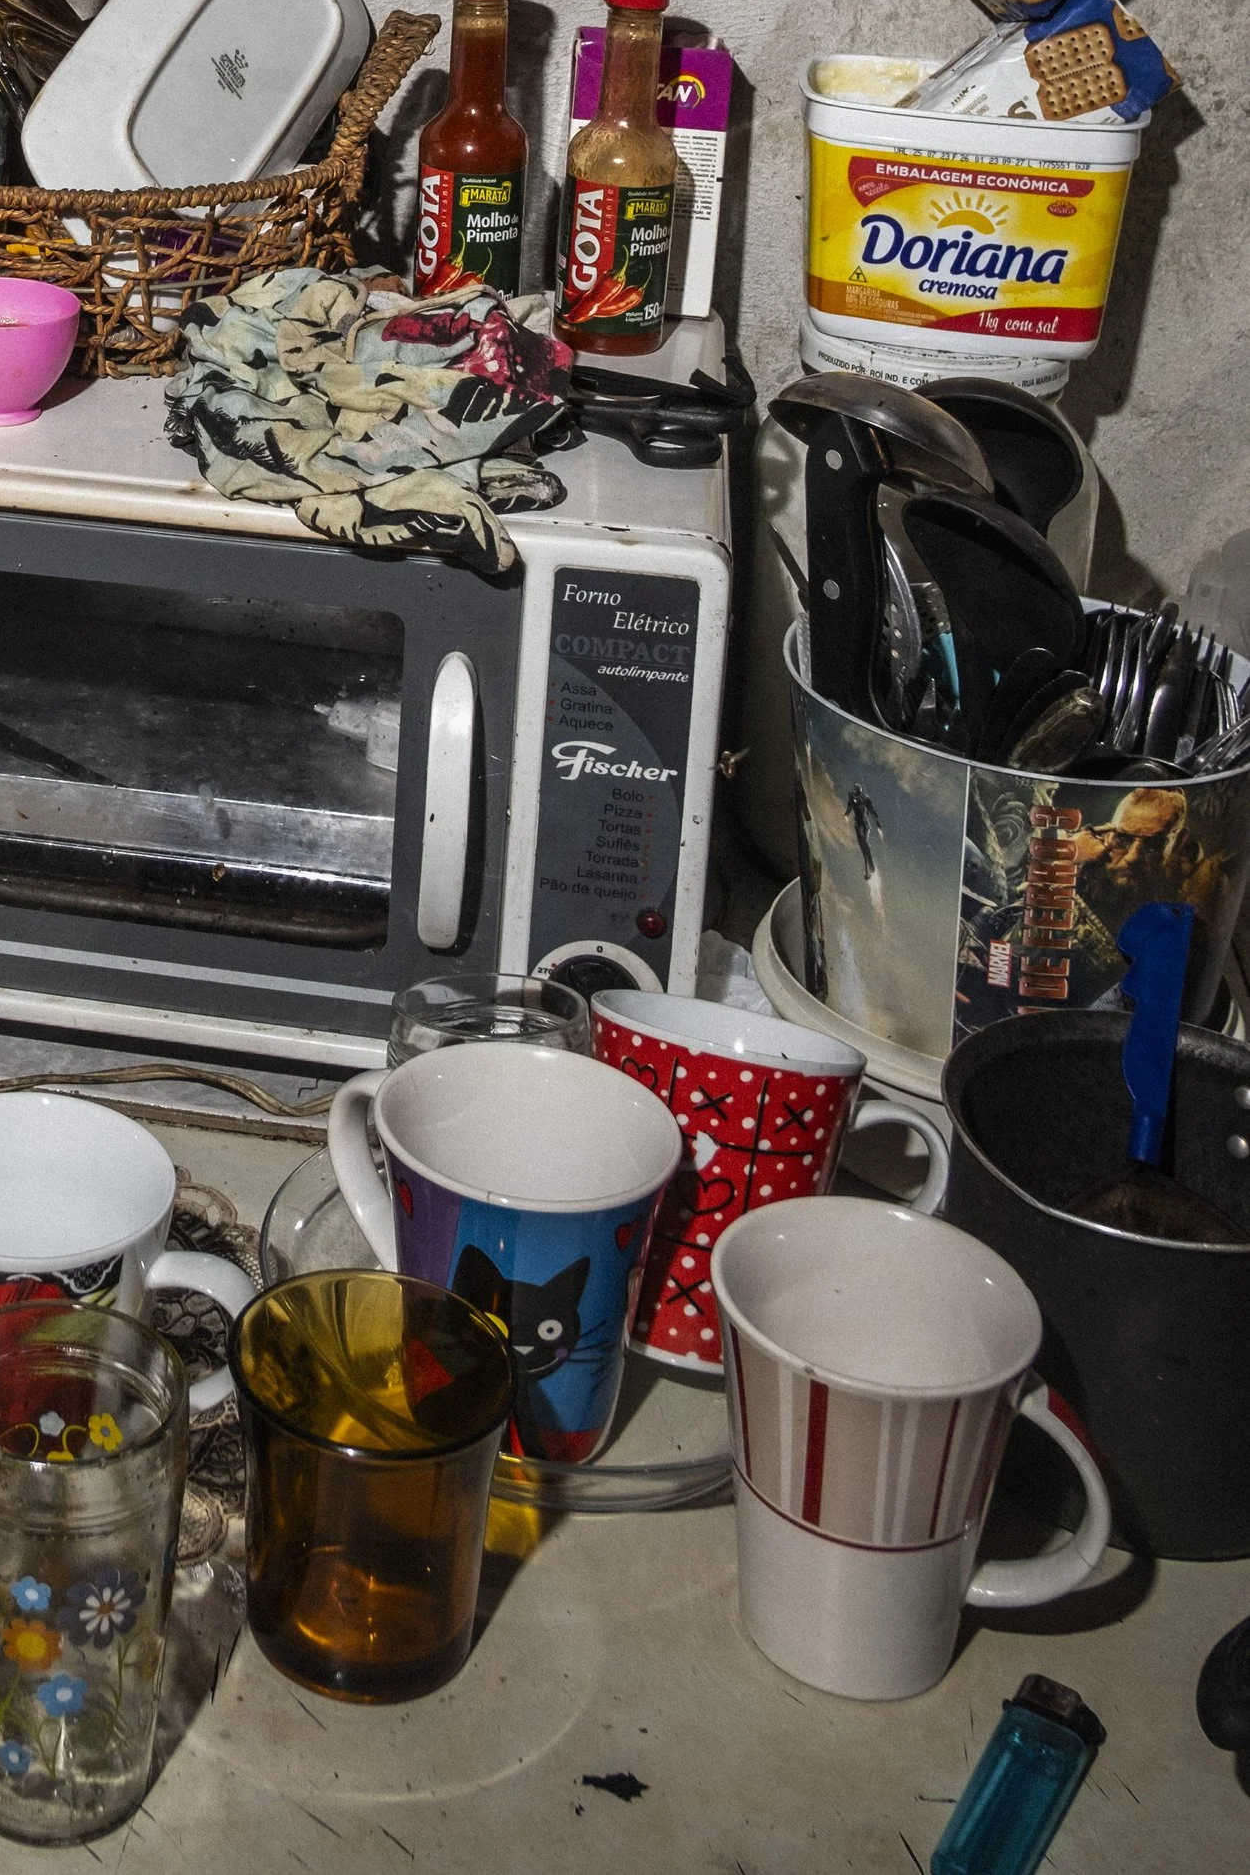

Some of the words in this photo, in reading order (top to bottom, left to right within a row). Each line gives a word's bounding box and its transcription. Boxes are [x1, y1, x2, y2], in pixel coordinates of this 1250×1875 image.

[876, 163, 973, 185] EMBALAGEM
[976, 173, 1069, 194] ECONÔMICA
[441, 173, 449, 228] picante
[418, 175, 441, 275] GOTA
[466, 212, 511, 228] Molho
[603, 189, 615, 243] picante
[466, 227, 519, 243] Pimenta
[572, 188, 604, 292] GOTA
[631, 224, 668, 241] Molho
[860, 213, 1069, 285] Doriana
[918, 278, 999, 300] cremosa
[1004, 319, 1034, 332] com
[1036, 315, 1058, 334] sal
[818, 350, 850, 370] PRODUZIDO
[562, 583, 622, 606] Forno
[612, 611, 690, 636] Elétrico
[554, 633, 691, 666] COMPACT
[597, 665, 690, 683] autolimpante
[560, 681, 598, 697] Assa
[560, 698, 614, 715] Gratina
[559, 714, 614, 732] Aquece
[551, 740, 679, 782] Fischer
[612, 787, 645, 803] Bolo
[603, 803, 643, 819] Pizza
[1029, 806, 1082, 830] 3
[598, 819, 642, 836] Tortas
[585, 850, 639, 868] Torrada
[576, 866, 638, 884] Lasanha
[539, 877, 568, 892] Pão
[572, 882, 590, 895] de
[594, 886, 637, 902] queijo
[1022, 836, 1079, 949] FERRO
[596, 945, 603, 953] 0
[987, 939, 1011, 986] MARVEL
[1019, 955, 1071, 998] DE
